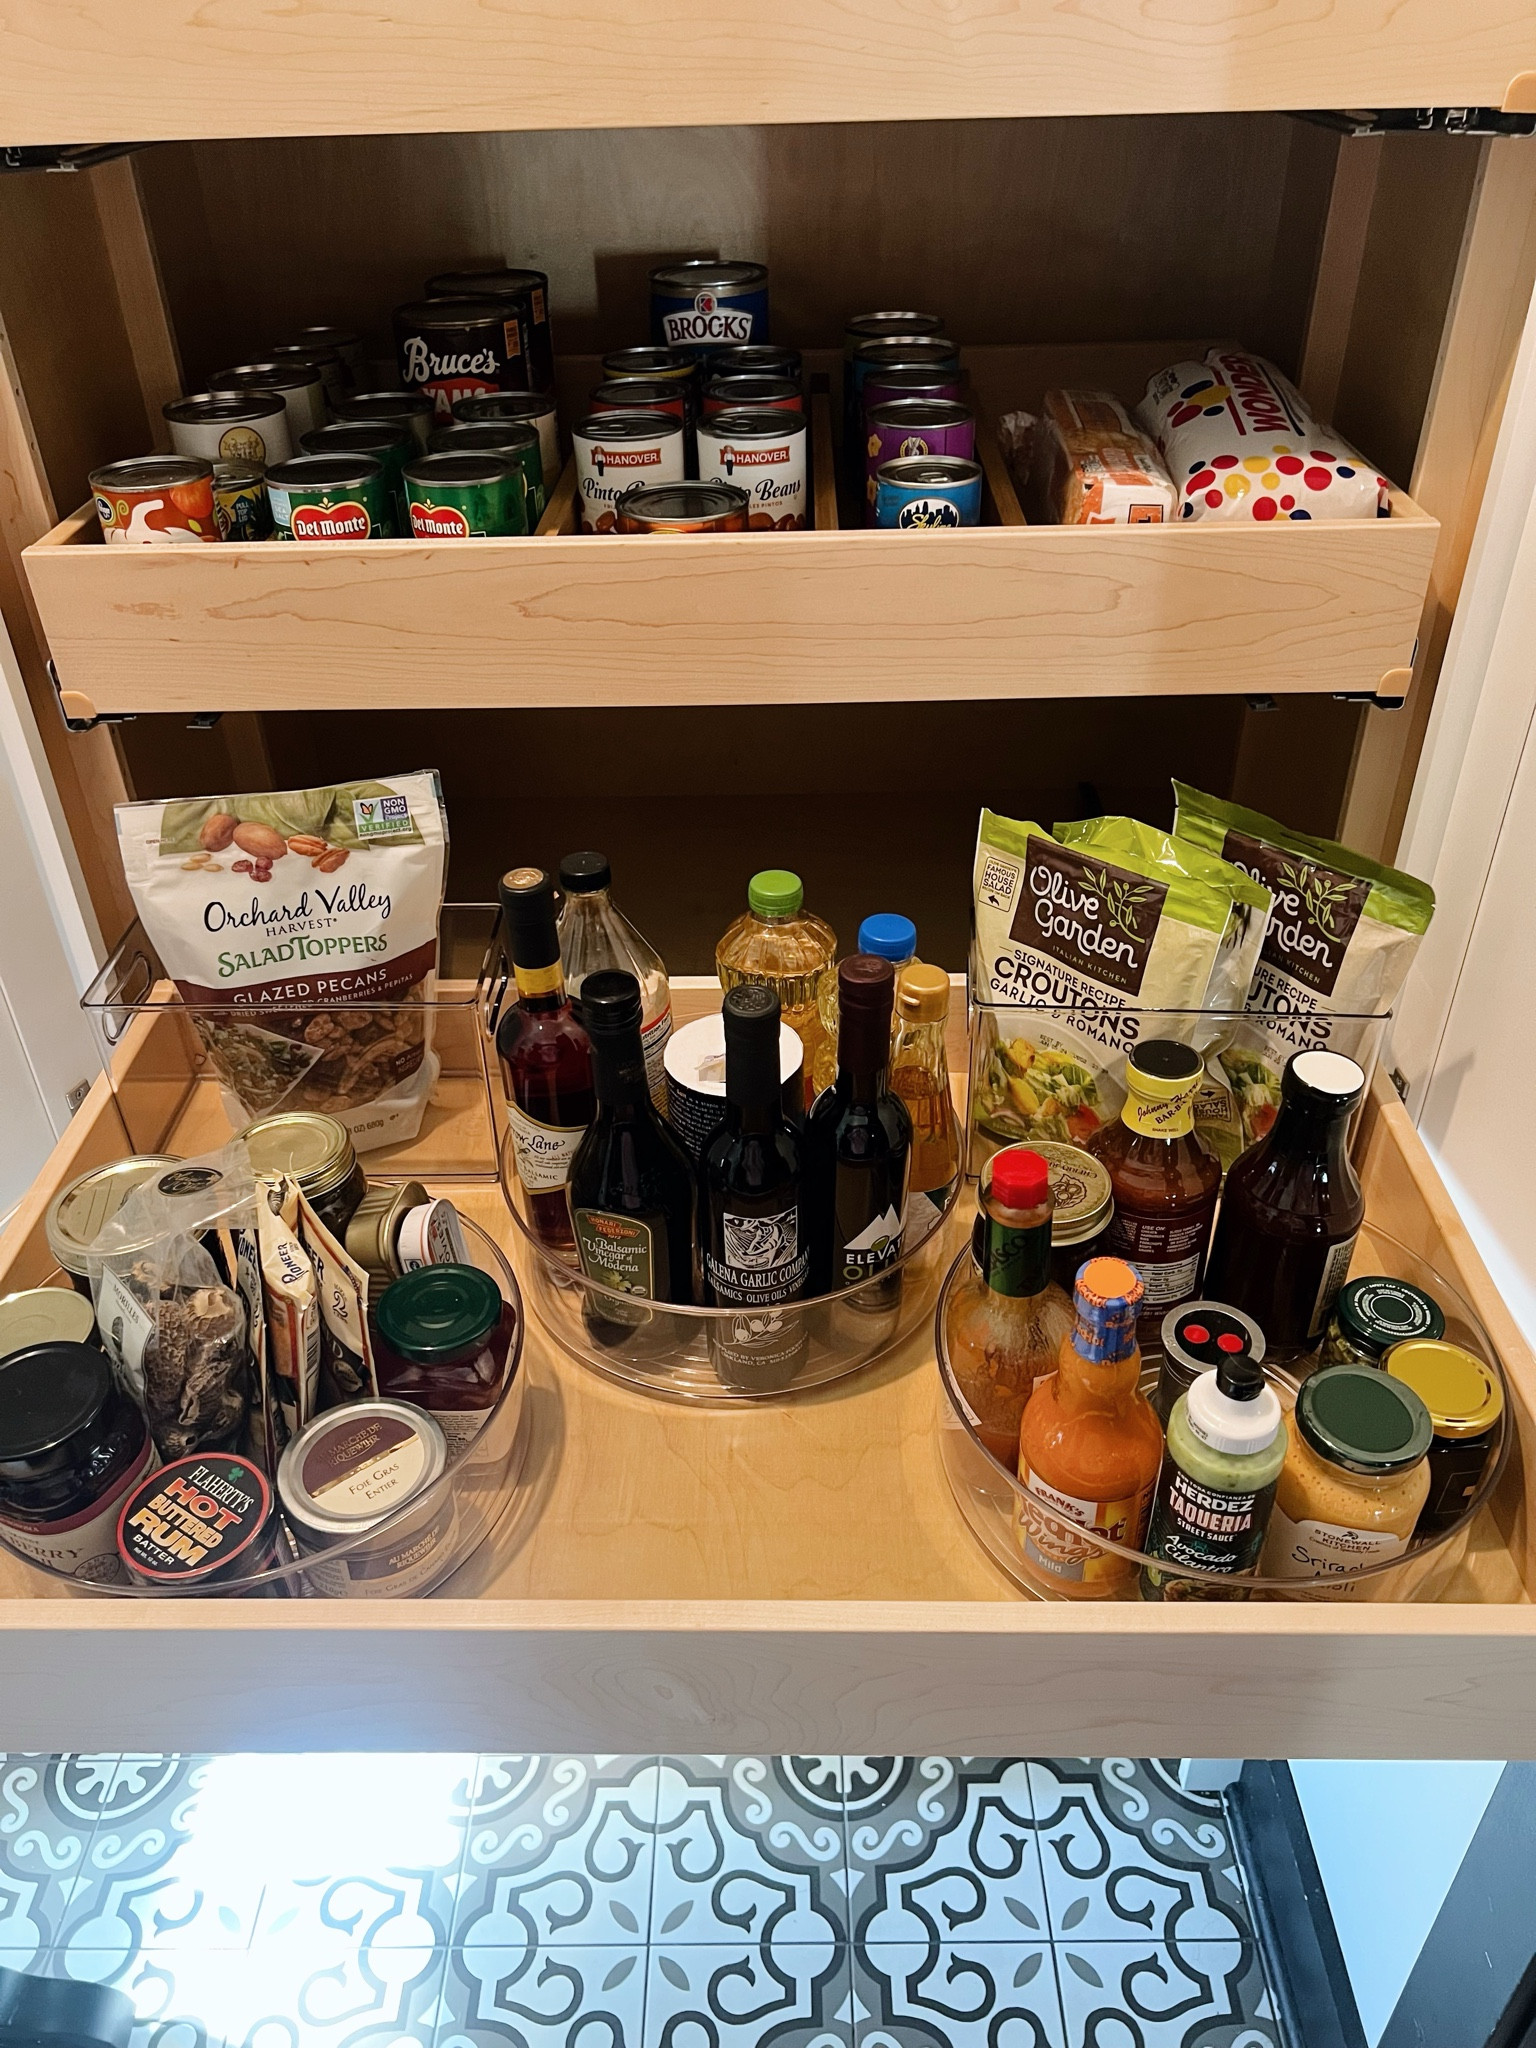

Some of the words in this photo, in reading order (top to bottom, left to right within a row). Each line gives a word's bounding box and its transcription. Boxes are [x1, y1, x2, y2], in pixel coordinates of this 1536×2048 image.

[403, 336, 500, 382] Bruce's
[1219, 355, 1291, 432] WONDER
[606, 453, 657, 464] HANOVER
[736, 451, 788, 463] HANOVER
[583, 477, 622, 501] Pinto
[236, 502, 249, 510] PULL
[296, 519, 319, 536] Del
[321, 517, 366, 535] Monte
[412, 516, 425, 532] Del
[426, 519, 463, 536] Monte
[383, 798, 404, 807] NON
[384, 805, 406, 814] GMO
[361, 820, 409, 832] VERIFIED
[985, 871, 1014, 888] HOUSE
[987, 864, 1016, 879] FAMOUS
[983, 879, 1011, 894] SALAD
[1029, 865, 1100, 919] Olive
[204, 891, 313, 932] Orchard
[315, 883, 391, 919] Valley
[266, 918, 337, 937] HARVEST
[1034, 899, 1138, 968] Garden
[1052, 945, 1084, 965] ITALIAN
[1087, 963, 1127, 984] KITCHEN
[233, 983, 310, 1005] GLAZED
[317, 968, 387, 993] PECANS
[318, 988, 376, 1004] CRANBERRIES
[384, 974, 413, 989] PEPITAS
[1014, 950, 1079, 987] SIGNATURE
[1080, 982, 1126, 1010] RECIPE
[1276, 978, 1318, 1010] RECIPE
[995, 957, 1140, 1040] CROUTONS
[1066, 1015, 1134, 1053] ROMANO
[1138, 1102, 1168, 1122] Johnny
[528, 1135, 565, 1154] Lane
[1061, 1165, 1098, 1179] CHERRY
[582, 1237, 626, 1261] Vinegar
[627, 1255, 633, 1264] of
[595, 1237, 647, 1254] Balsamic
[277, 1242, 309, 1284] PIONEER
[588, 1252, 639, 1272] Modena
[707, 1253, 738, 1285] GALENA
[740, 1271, 778, 1288] GARLIC
[707, 1271, 742, 1301] BALSAMICS
[747, 1293, 769, 1303] OLIVE
[771, 1288, 787, 1300] OILS
[113, 1284, 140, 1325] MORILLES
[368, 1423, 382, 1434] DE
[188, 1465, 254, 1513] FLAHERTY'S
[349, 1479, 372, 1494] FOIE
[373, 1463, 399, 1480] GRAS
[365, 1479, 399, 1499] ENTIER
[1190, 1482, 1205, 1492] TODA
[1205, 1491, 1247, 1500] CONFIANZA
[164, 1477, 242, 1530] HOT
[1035, 1486, 1085, 1517] FRANK'S
[1176, 1476, 1255, 1512] HERDEZ
[147, 1493, 223, 1548] BUTTERED
[1169, 1485, 1252, 1532] TAQUERIA
[128, 1507, 208, 1566] RUM
[1177, 1517, 1205, 1538] STREET
[1207, 1533, 1234, 1542] SAUCE
[1315, 1529, 1380, 1545] STONEWALL
[133, 1534, 175, 1565] BATTER
[1165, 1543, 1235, 1573] Cilantro
[1167, 1535, 1238, 1563] Avocado
[1322, 1538, 1371, 1551] KITCHEN
[1038, 1554, 1062, 1573] Mild
